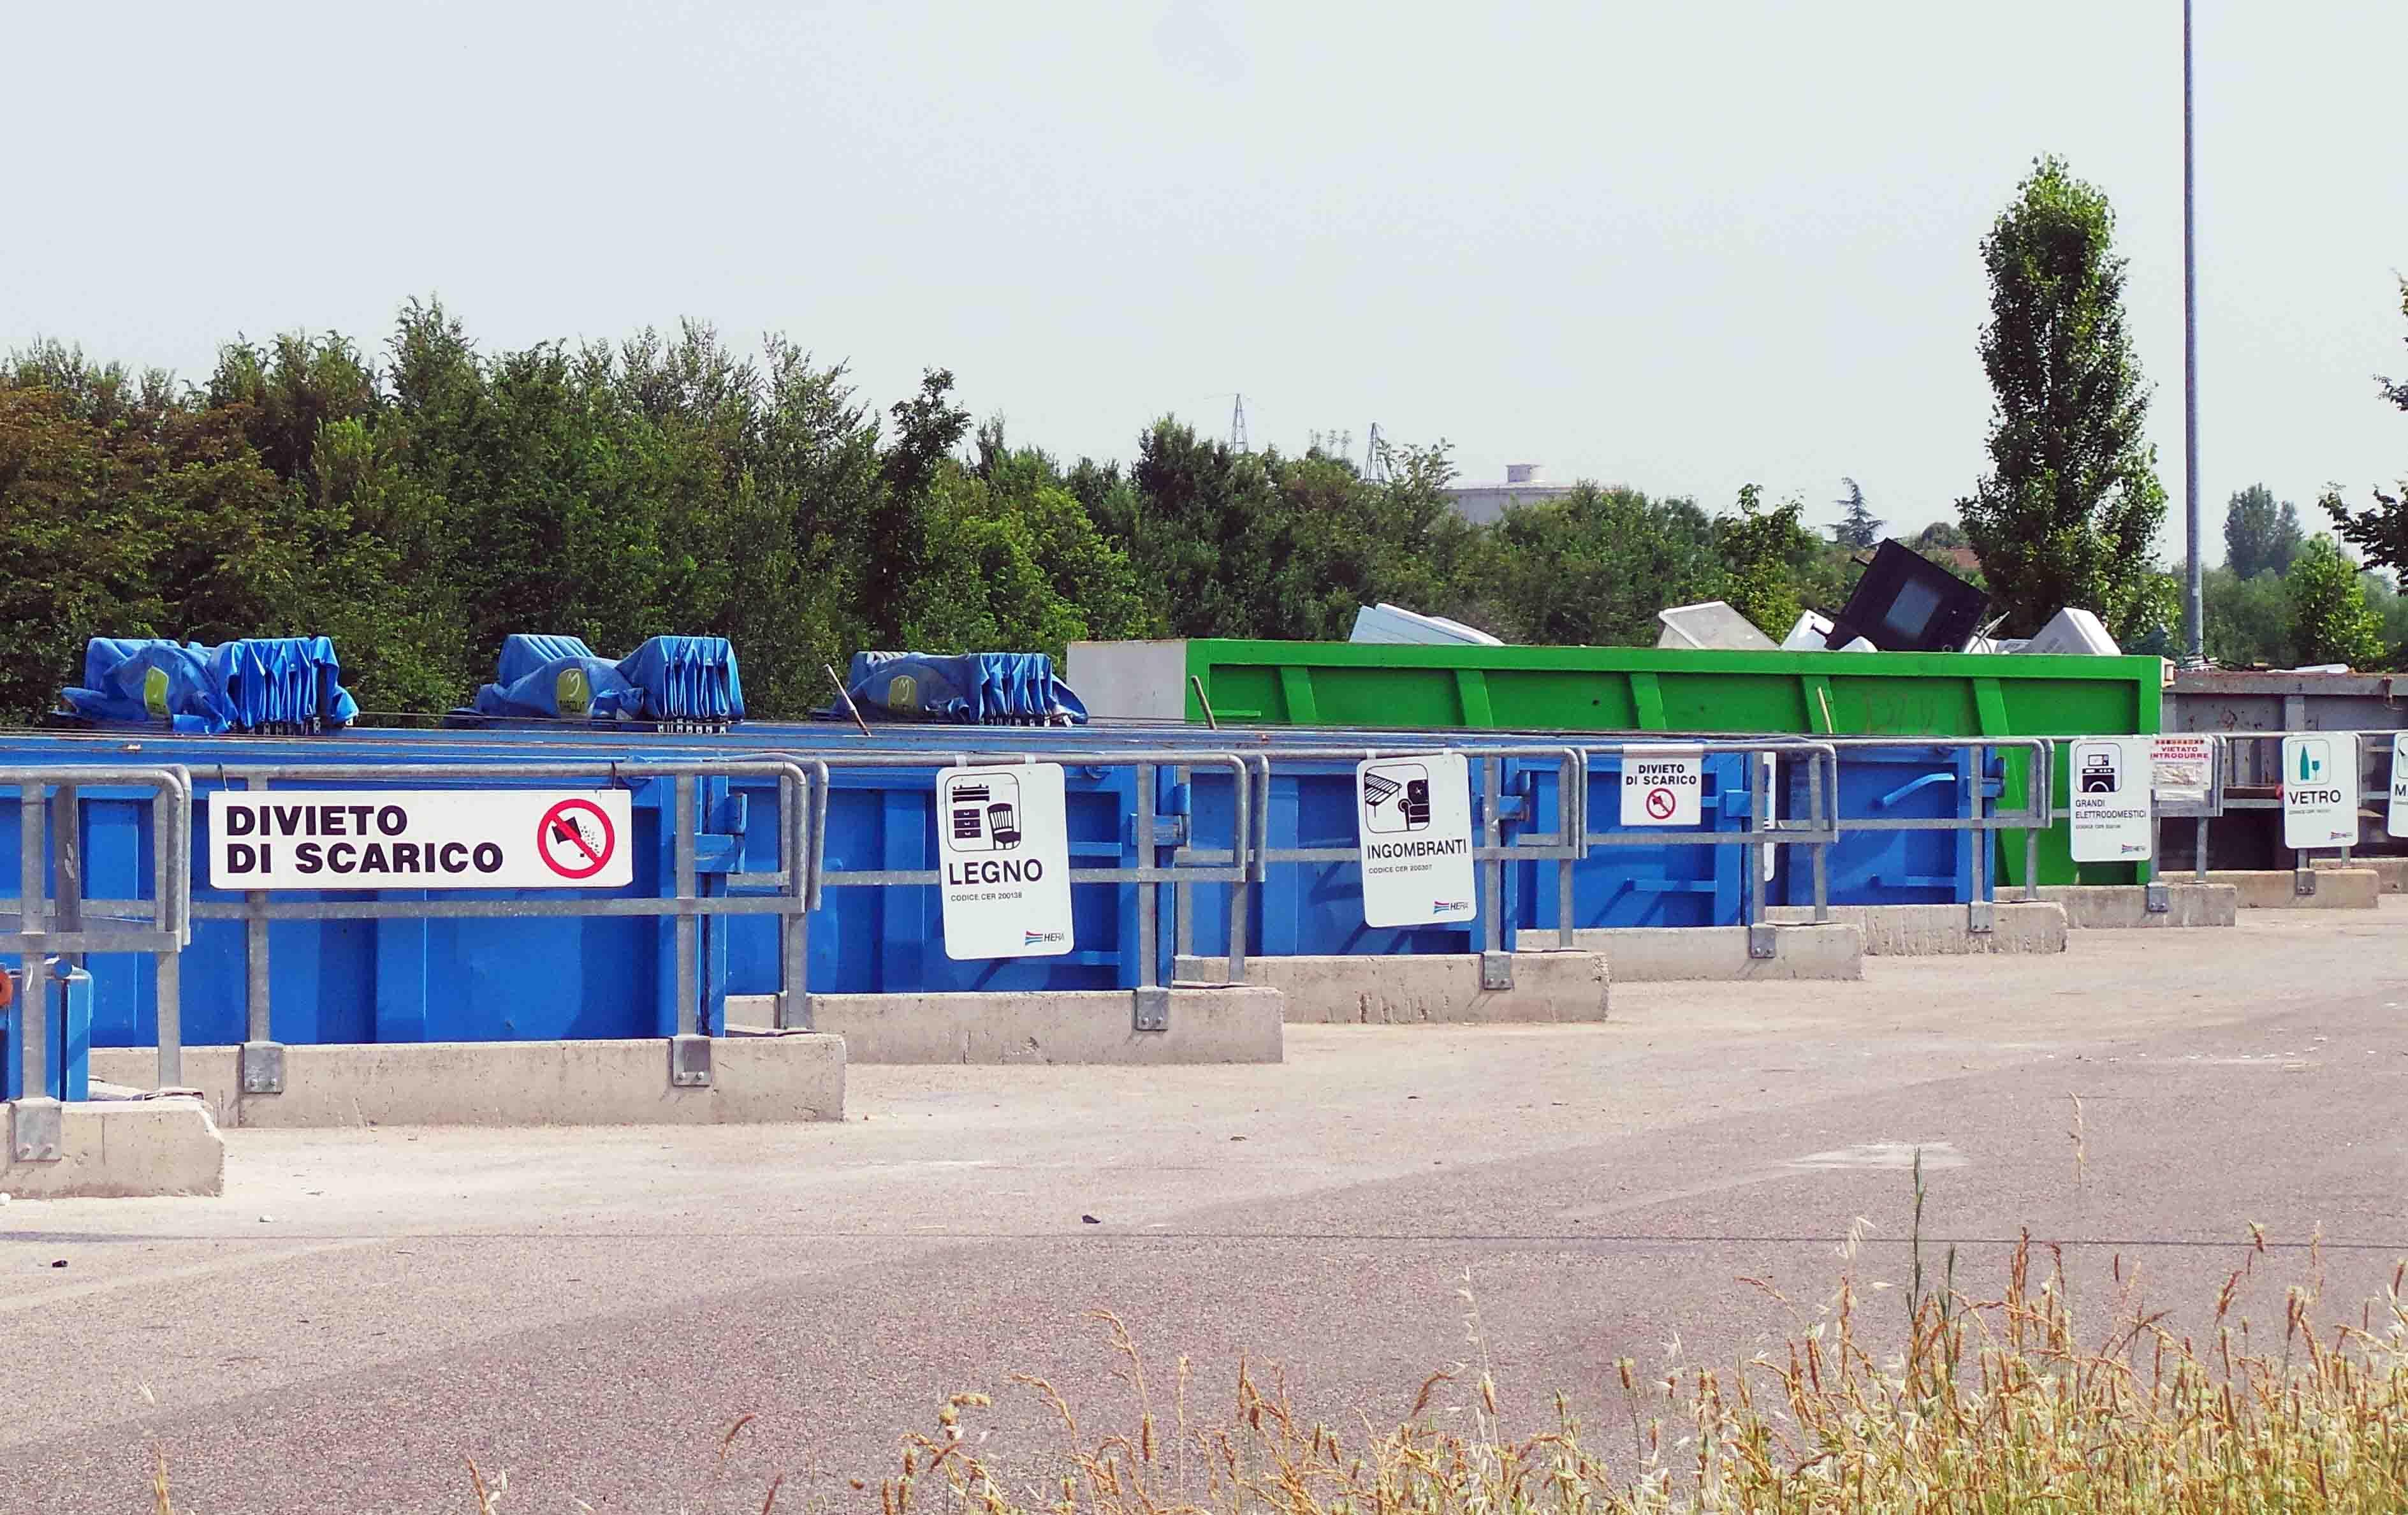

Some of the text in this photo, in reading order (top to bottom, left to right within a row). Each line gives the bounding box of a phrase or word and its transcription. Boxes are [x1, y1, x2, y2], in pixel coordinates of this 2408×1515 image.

[1638, 764, 1685, 774] DIVIETO
[1626, 775, 1697, 786] DI SCARICO
[2395, 784, 2408, 796] M
[2289, 789, 2342, 805] VETRO
[2075, 799, 2105, 808] GRANDI
[2075, 810, 2147, 819] ELETTRODOMESTICI
[226, 805, 407, 837] DIVIETO
[1367, 838, 1467, 860] INGOMBRANTI
[227, 842, 504, 874] DI SCARICO
[949, 858, 1043, 886] LEGNO
[951, 893, 979, 902] CODICE
[1044, 933, 1065, 942] HERA
